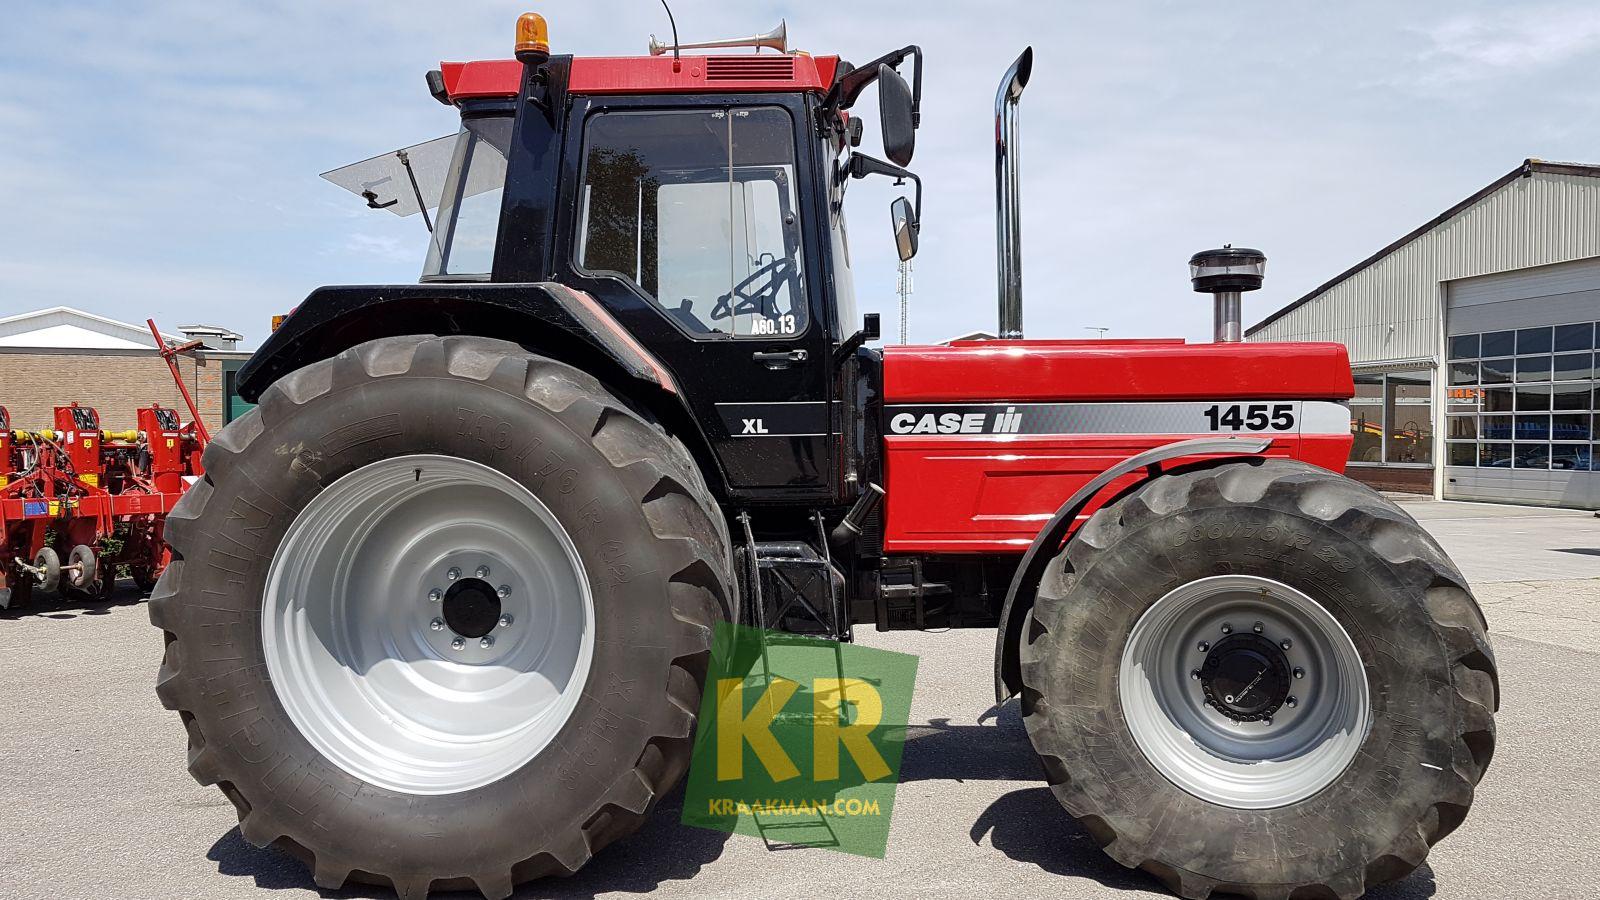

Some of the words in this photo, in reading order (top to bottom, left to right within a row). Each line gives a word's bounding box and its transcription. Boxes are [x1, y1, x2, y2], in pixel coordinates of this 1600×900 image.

[742, 419, 768, 434] XL
[890, 412, 986, 434] CASE
[1204, 405, 1294, 431] 1455
